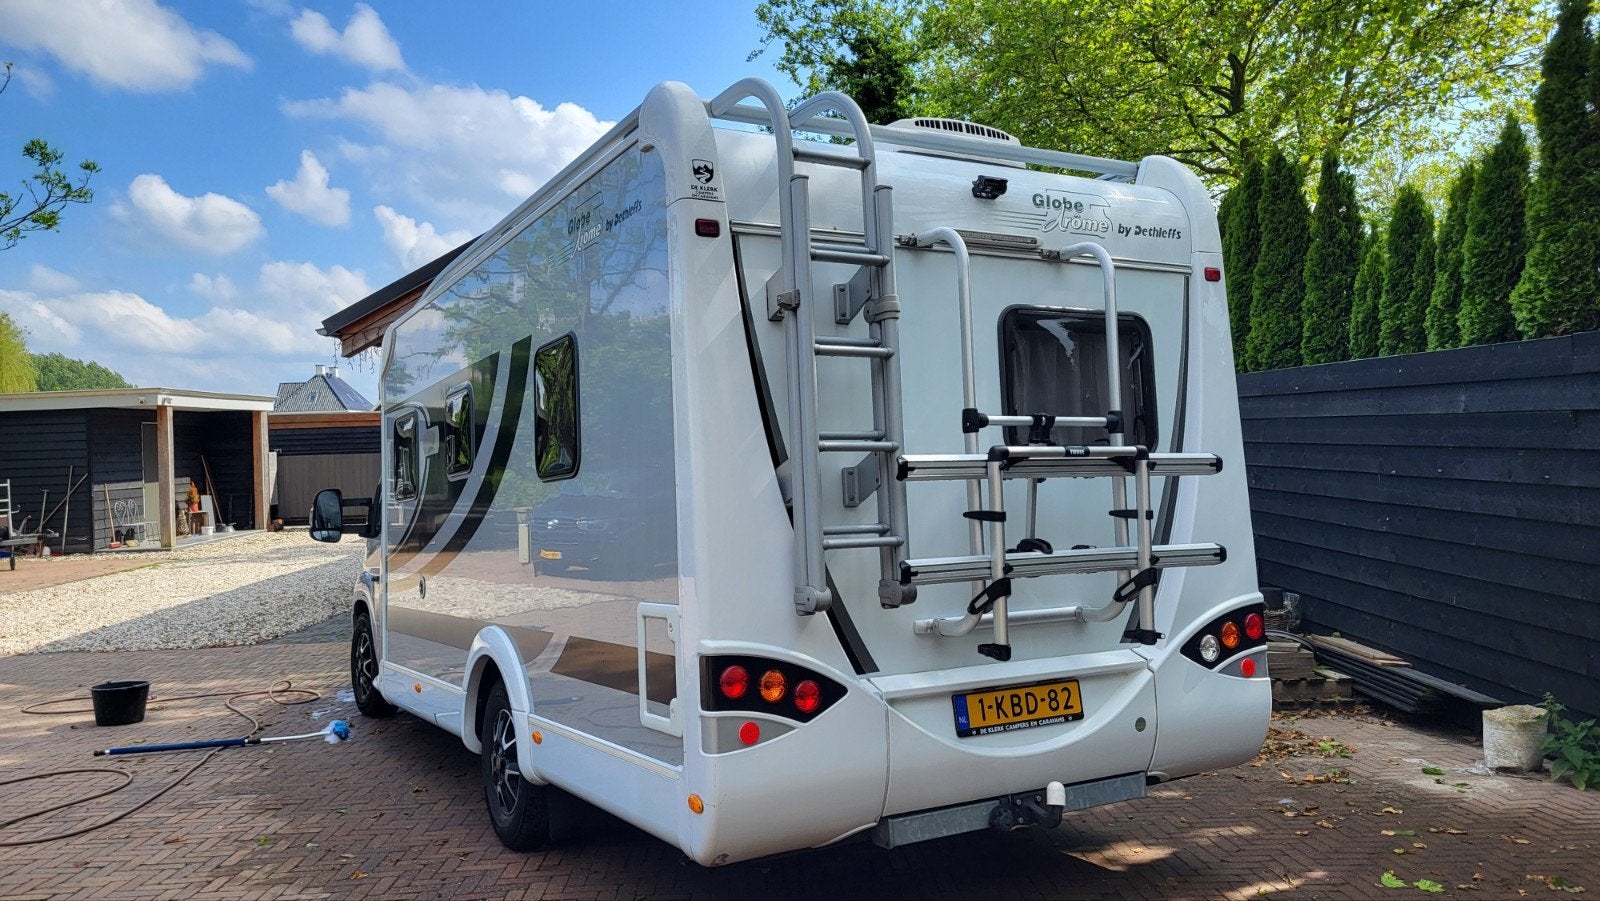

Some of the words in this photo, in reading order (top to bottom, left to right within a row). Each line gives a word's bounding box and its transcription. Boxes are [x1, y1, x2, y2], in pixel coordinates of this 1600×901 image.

[1032, 193, 1084, 212] Globe
[568, 210, 591, 235] Globe
[605, 218, 614, 232] by
[614, 199, 642, 226] Dethleffs
[1117, 223, 1132, 237] by
[1134, 225, 1182, 239] Dethleffs
[978, 686, 1074, 722] 1-KBD-82
[958, 716, 967, 724] NL
[1005, 721, 1030, 730] CAMPERS
[1038, 716, 1065, 726] CARAVANS
